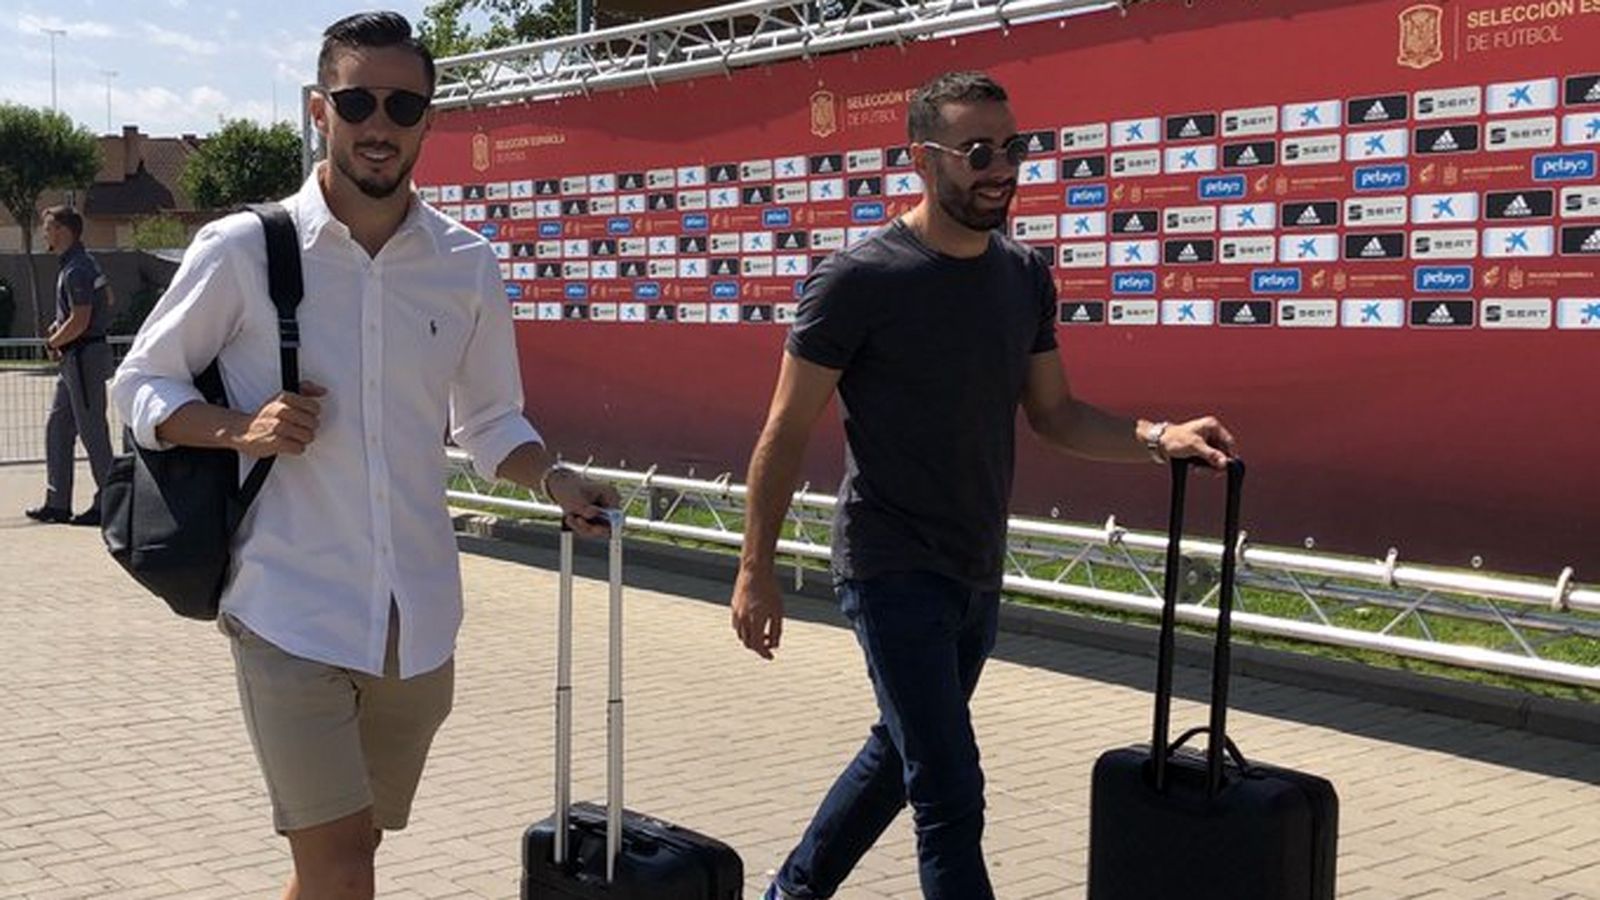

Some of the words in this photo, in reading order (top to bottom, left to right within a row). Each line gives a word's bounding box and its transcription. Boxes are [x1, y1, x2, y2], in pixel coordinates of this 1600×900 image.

[1467, 34, 1488, 51] DE
[1438, 97, 1476, 108] SEAT
[1241, 116, 1273, 126] SEAT
[1511, 128, 1551, 138] SEAT
[1302, 145, 1336, 155] SEAT
[1542, 159, 1588, 175] pelayo
[1362, 169, 1400, 186] pelayo
[1366, 207, 1402, 216] SEAT
[1434, 239, 1472, 249] SEAT
[1423, 271, 1465, 286] pelayo
[1506, 309, 1547, 318] SEAT
